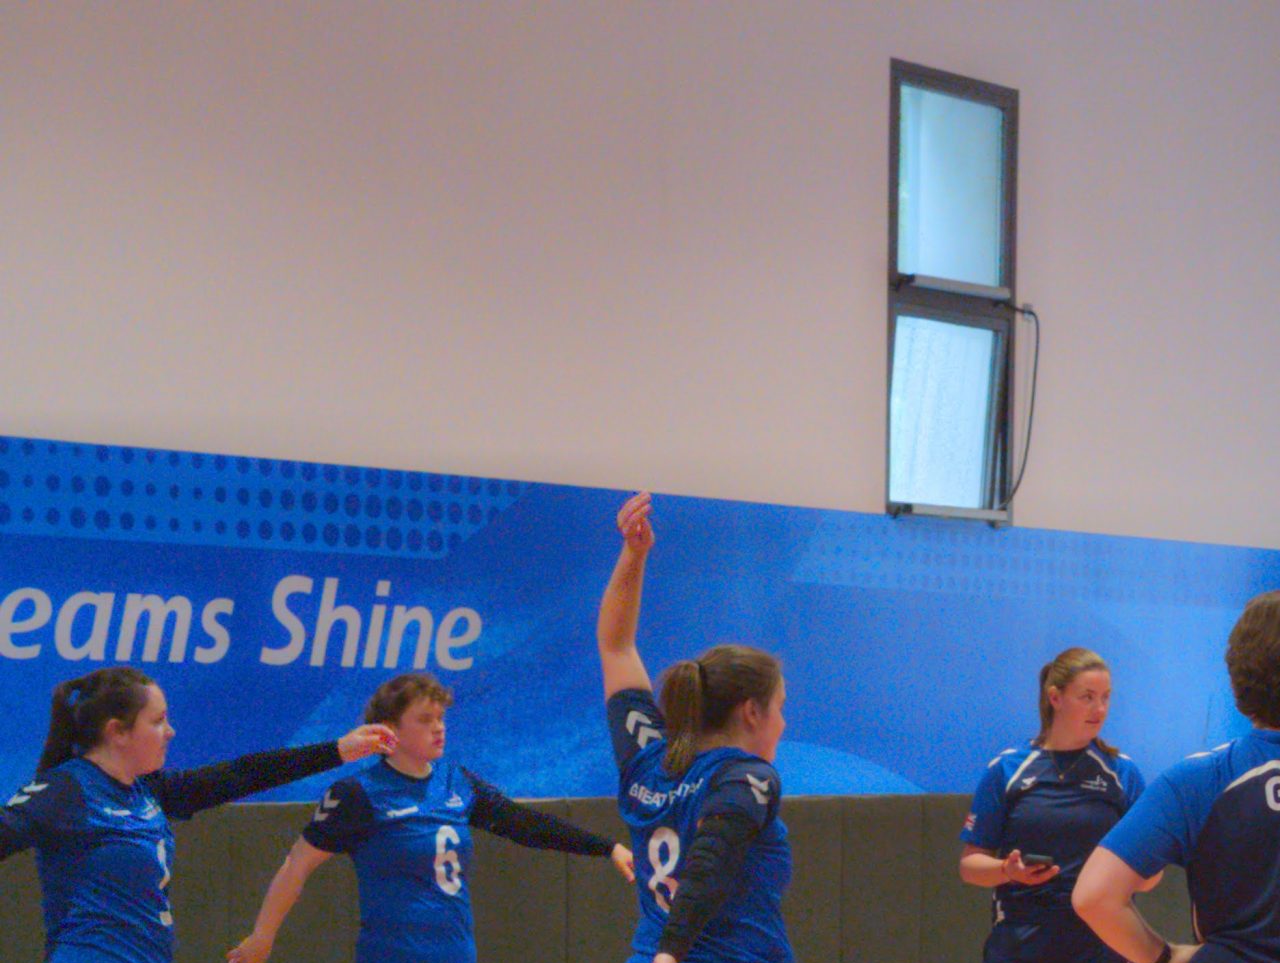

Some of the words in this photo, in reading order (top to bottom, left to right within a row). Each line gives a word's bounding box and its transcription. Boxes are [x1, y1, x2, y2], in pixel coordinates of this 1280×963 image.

[260, 575, 482, 670] Shine
[434, 825, 461, 895] 6
[648, 827, 680, 913] 8
